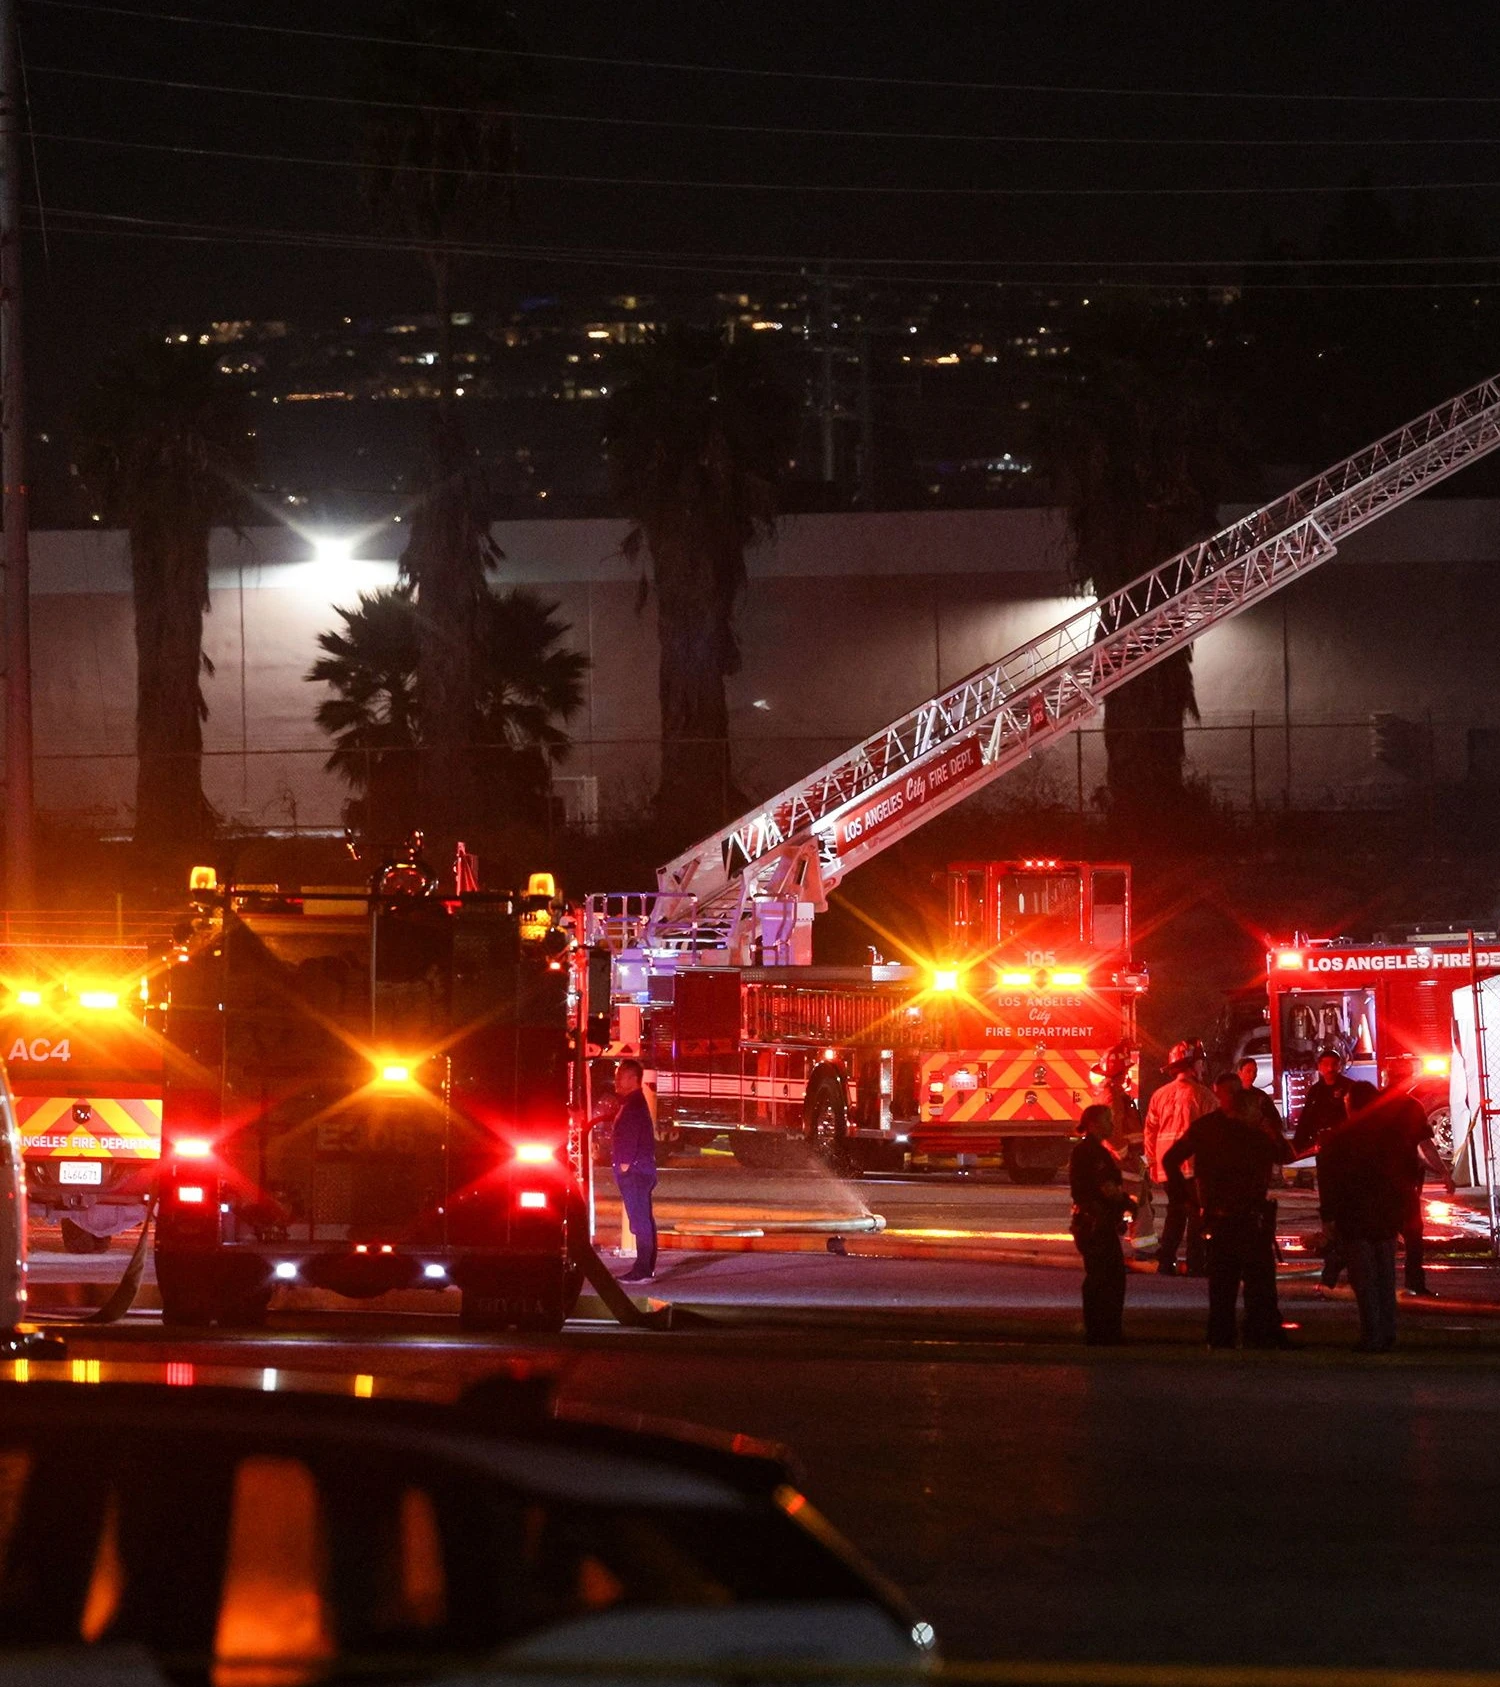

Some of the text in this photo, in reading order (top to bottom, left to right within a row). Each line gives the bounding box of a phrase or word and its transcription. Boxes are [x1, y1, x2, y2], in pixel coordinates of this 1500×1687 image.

[843, 748, 974, 842] LOS ANGELES City FIRE DEPT.
[1024, 950, 1056, 967] 105
[1308, 957, 1344, 972] LOS
[1344, 954, 1431, 970] ANGELES
[1432, 952, 1471, 968] FIRE
[998, 996, 1082, 1007] LOS ANGELES
[1028, 1007, 1051, 1026] City
[985, 1026, 1094, 1037] FIRE DEPARTMENT
[8, 1038, 71, 1062] AC4
[72, 1137, 96, 1149] FIRE
[100, 1137, 160, 1151] DEPARTME
